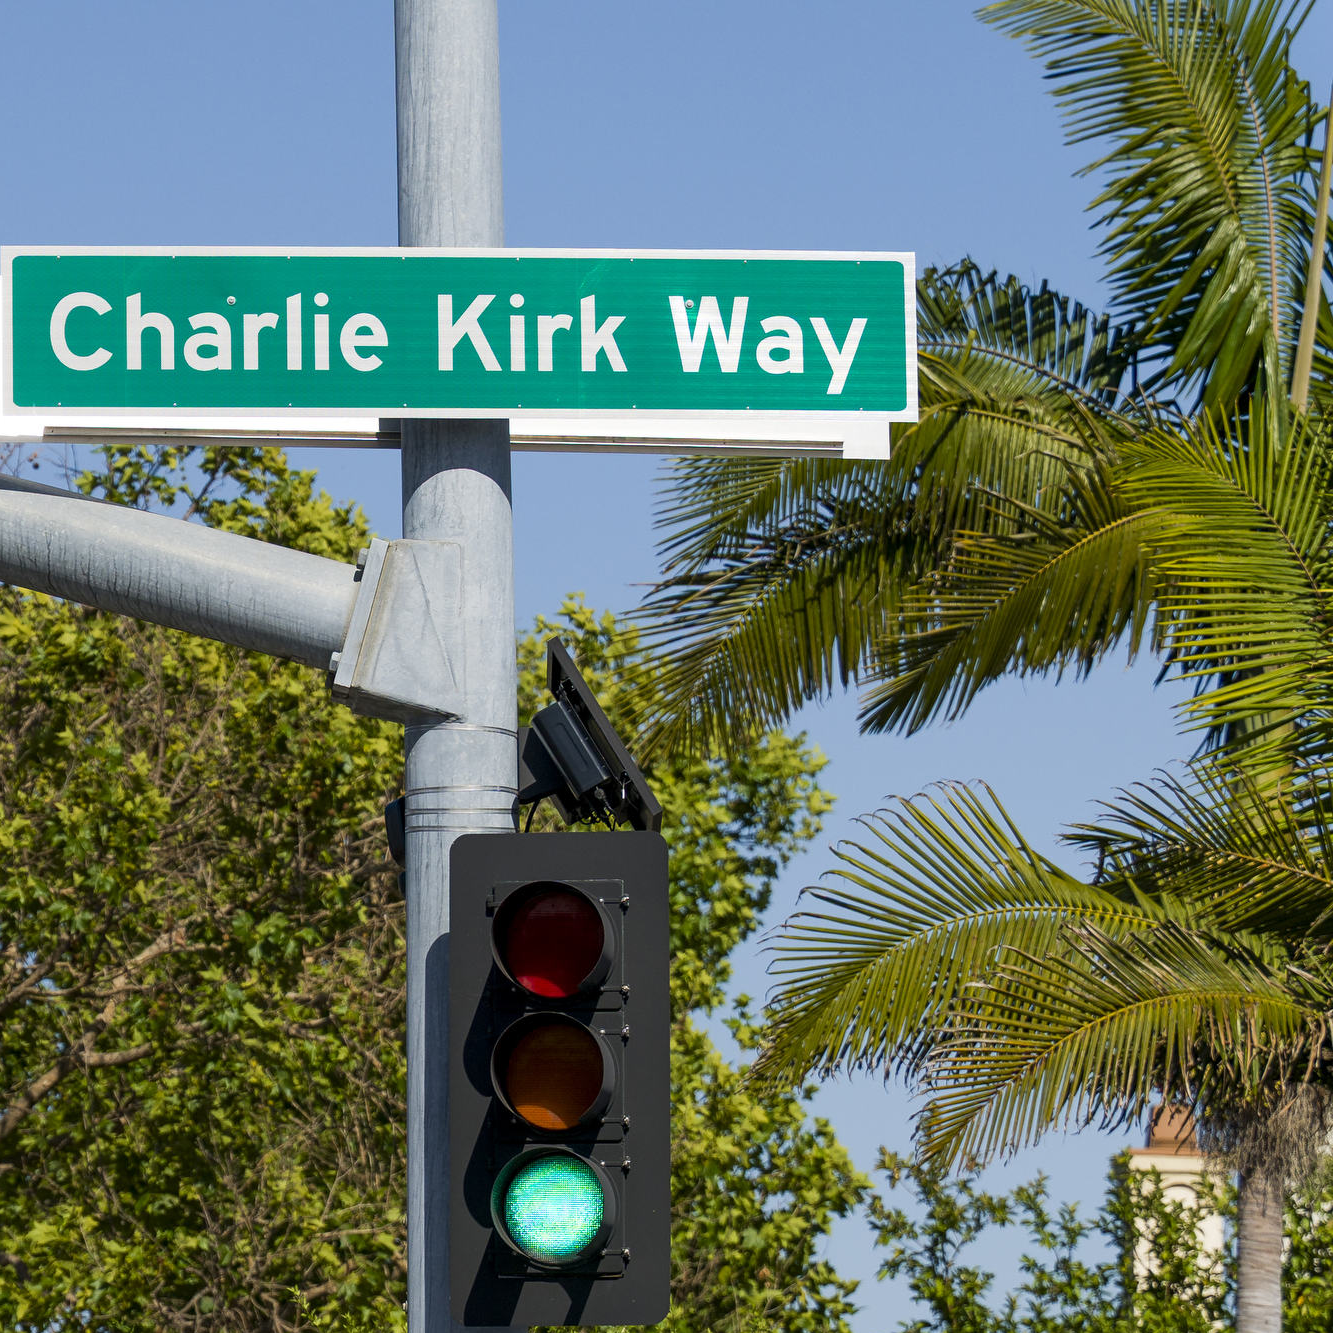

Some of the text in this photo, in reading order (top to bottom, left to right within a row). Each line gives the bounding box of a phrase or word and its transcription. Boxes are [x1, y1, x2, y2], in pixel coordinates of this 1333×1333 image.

[48, 291, 868, 395] Charlie Kirk Way
